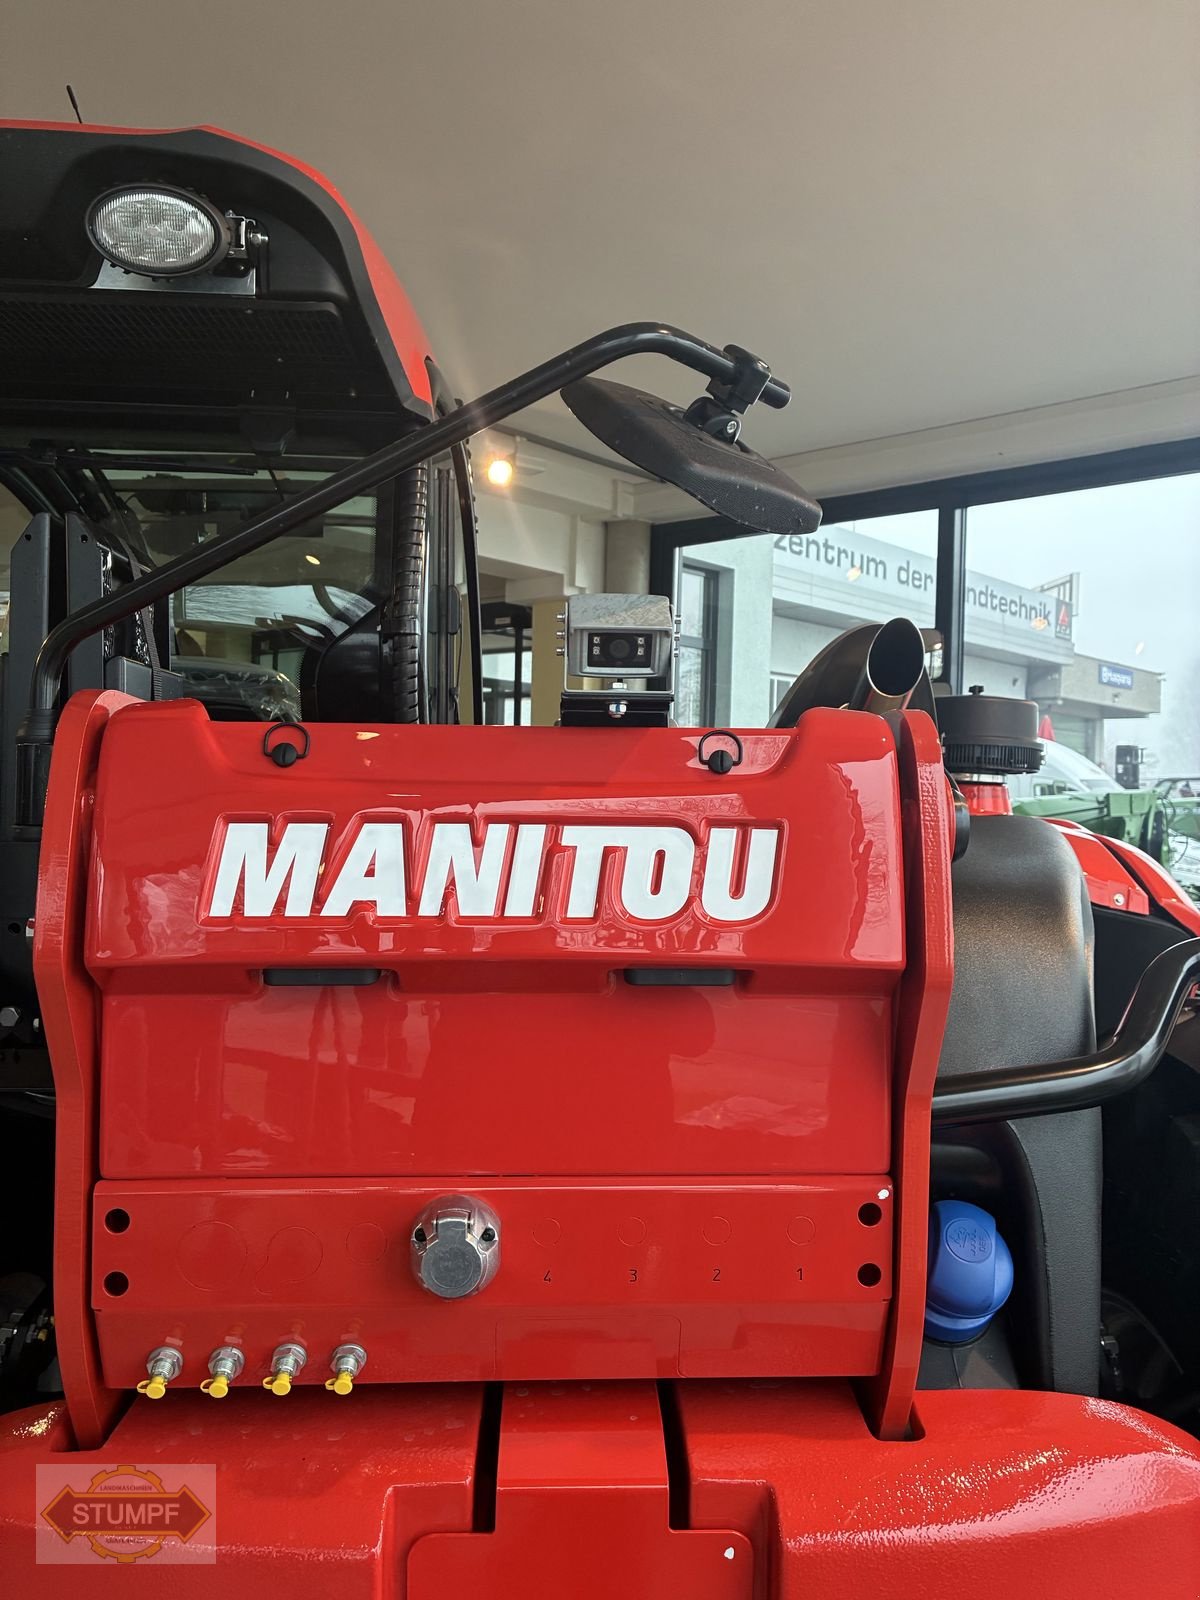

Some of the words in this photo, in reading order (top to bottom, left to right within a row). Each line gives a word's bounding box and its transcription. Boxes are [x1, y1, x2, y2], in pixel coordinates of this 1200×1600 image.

[896, 560, 934, 592] der
[966, 585, 1052, 627] ndtechnik
[208, 822, 779, 922] MANITOU
[543, 1269, 552, 1283] 4
[629, 1269, 638, 1283] 3
[712, 1268, 721, 1282] 2
[796, 1268, 804, 1281] 1
